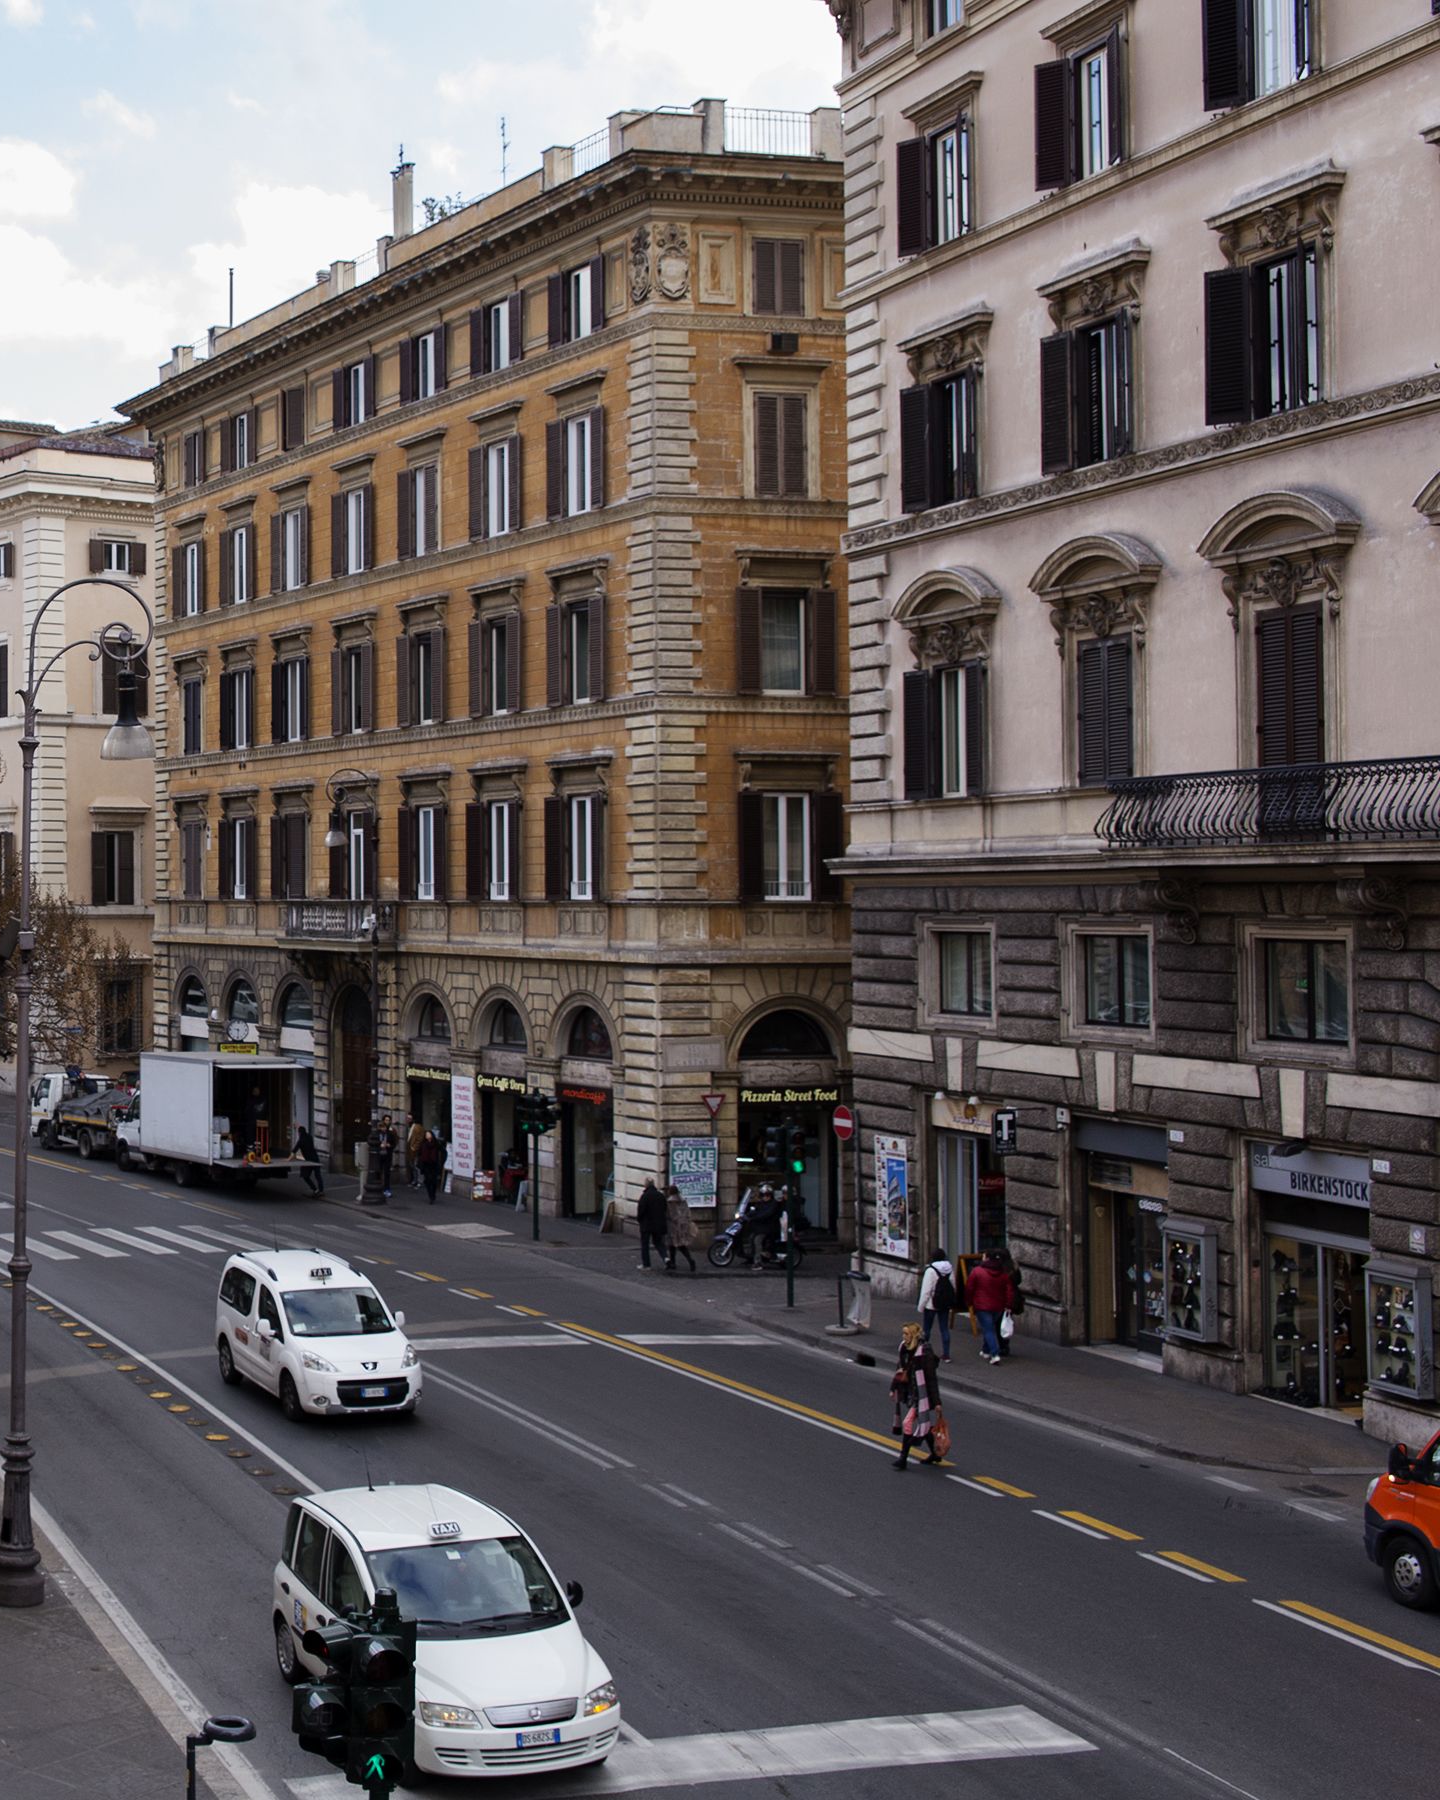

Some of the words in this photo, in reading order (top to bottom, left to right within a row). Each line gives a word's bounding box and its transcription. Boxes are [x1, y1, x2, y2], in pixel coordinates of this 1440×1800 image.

[477, 1073, 493, 1088] Gran
[740, 1089, 783, 1103] Pizzeria
[783, 1089, 812, 1102] Street
[813, 1088, 838, 1101] Food
[996, 1113, 1014, 1141] T
[673, 1147, 696, 1162] GIÙ
[698, 1150, 715, 1161] LE
[673, 1161, 715, 1173] TASSE
[1290, 1172, 1369, 1202] BIRKENSTOCK
[310, 1267, 332, 1278] TAXI
[431, 1521, 460, 1536] TAXI
